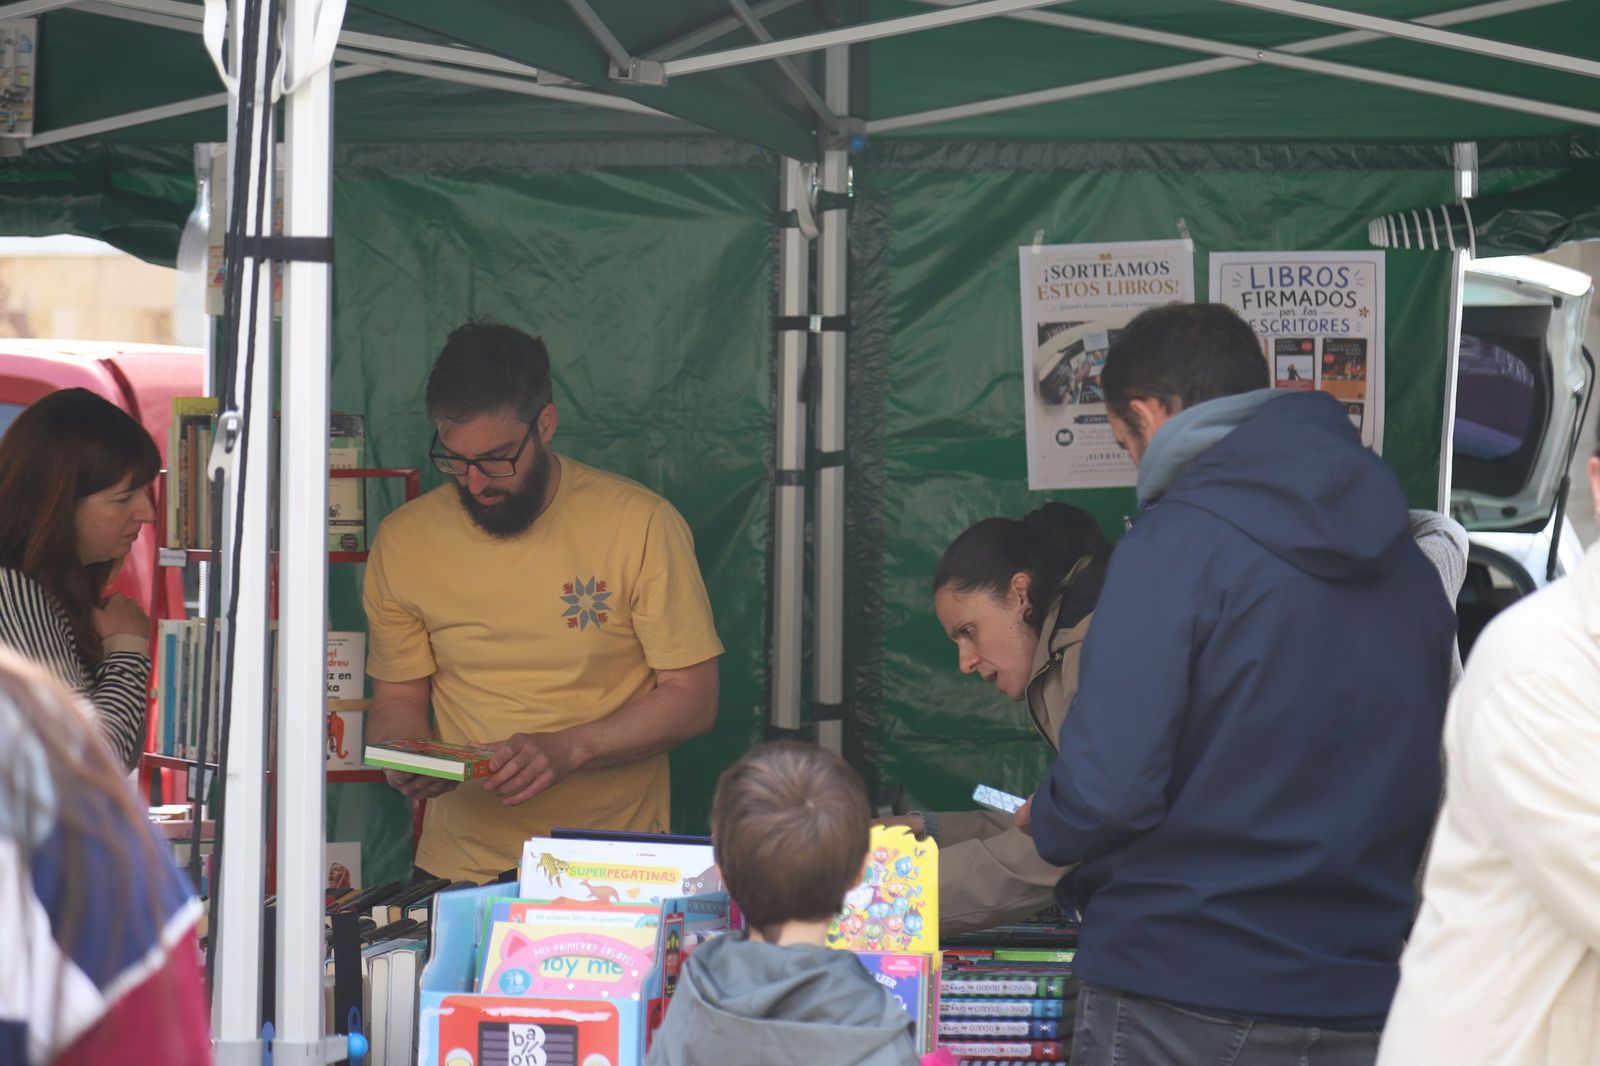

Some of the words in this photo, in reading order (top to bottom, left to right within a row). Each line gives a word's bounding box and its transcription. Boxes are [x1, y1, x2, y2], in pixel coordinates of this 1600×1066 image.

[1044, 261, 1170, 283] ¡SORTEAMOS
[1250, 265, 1350, 289] LIBROS
[1037, 281, 1100, 300] ESTOS
[1106, 279, 1179, 297] LIBROS!
[1241, 290, 1357, 310] FIRMADOS
[1279, 309, 1296, 319] por
[1302, 306, 1318, 317] los
[1250, 318, 1350, 334] ESCRITORES
[327, 648, 337, 658] el
[338, 672, 352, 680] en
[569, 865, 677, 882] SUPERPEGATINAS
[534, 947, 550, 958] MIS
[553, 942, 599, 952] PRIMEROS
[600, 945, 635, 967] COLORES
[875, 973, 897, 989] LEER
